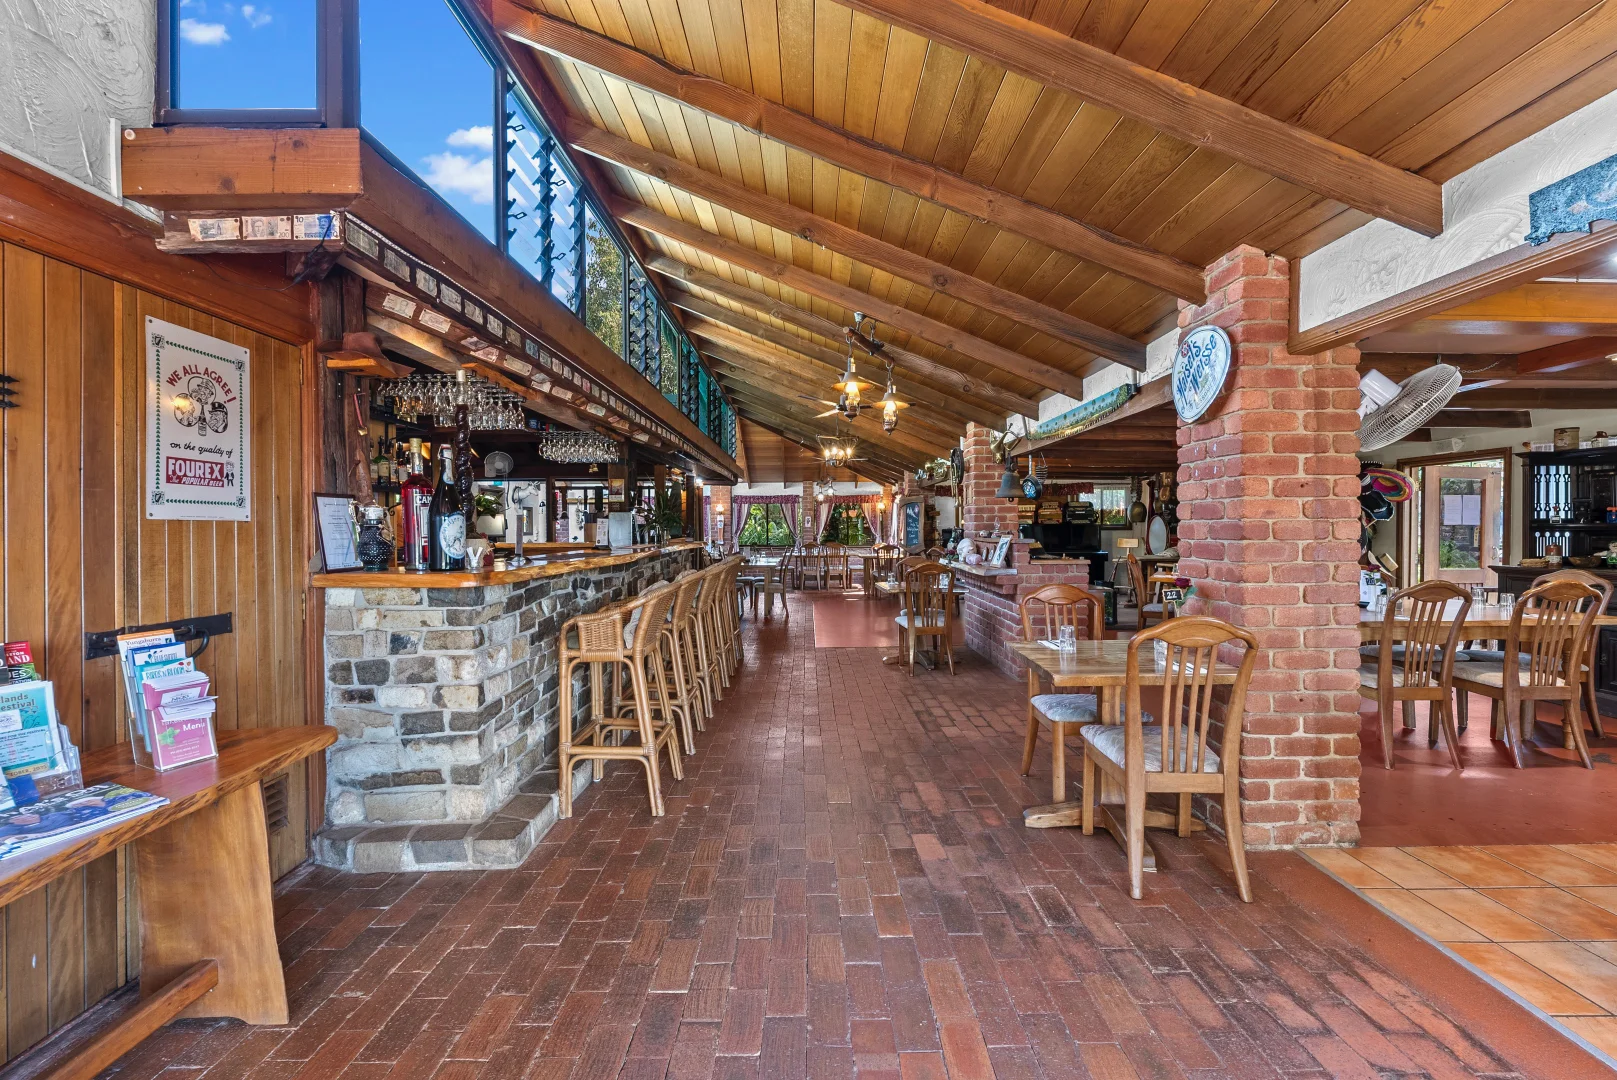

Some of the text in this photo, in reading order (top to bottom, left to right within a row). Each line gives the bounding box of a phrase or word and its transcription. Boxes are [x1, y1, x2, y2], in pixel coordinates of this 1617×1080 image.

[166, 370, 182, 387] WE
[182, 364, 202, 377] ALL
[183, 440, 196, 451] the
[197, 444, 225, 457] quality
[225, 448, 234, 459] of
[167, 458, 222, 479] FOUREX
[1166, 591, 1177, 599] 22
[182, 722, 205, 731] Menu
